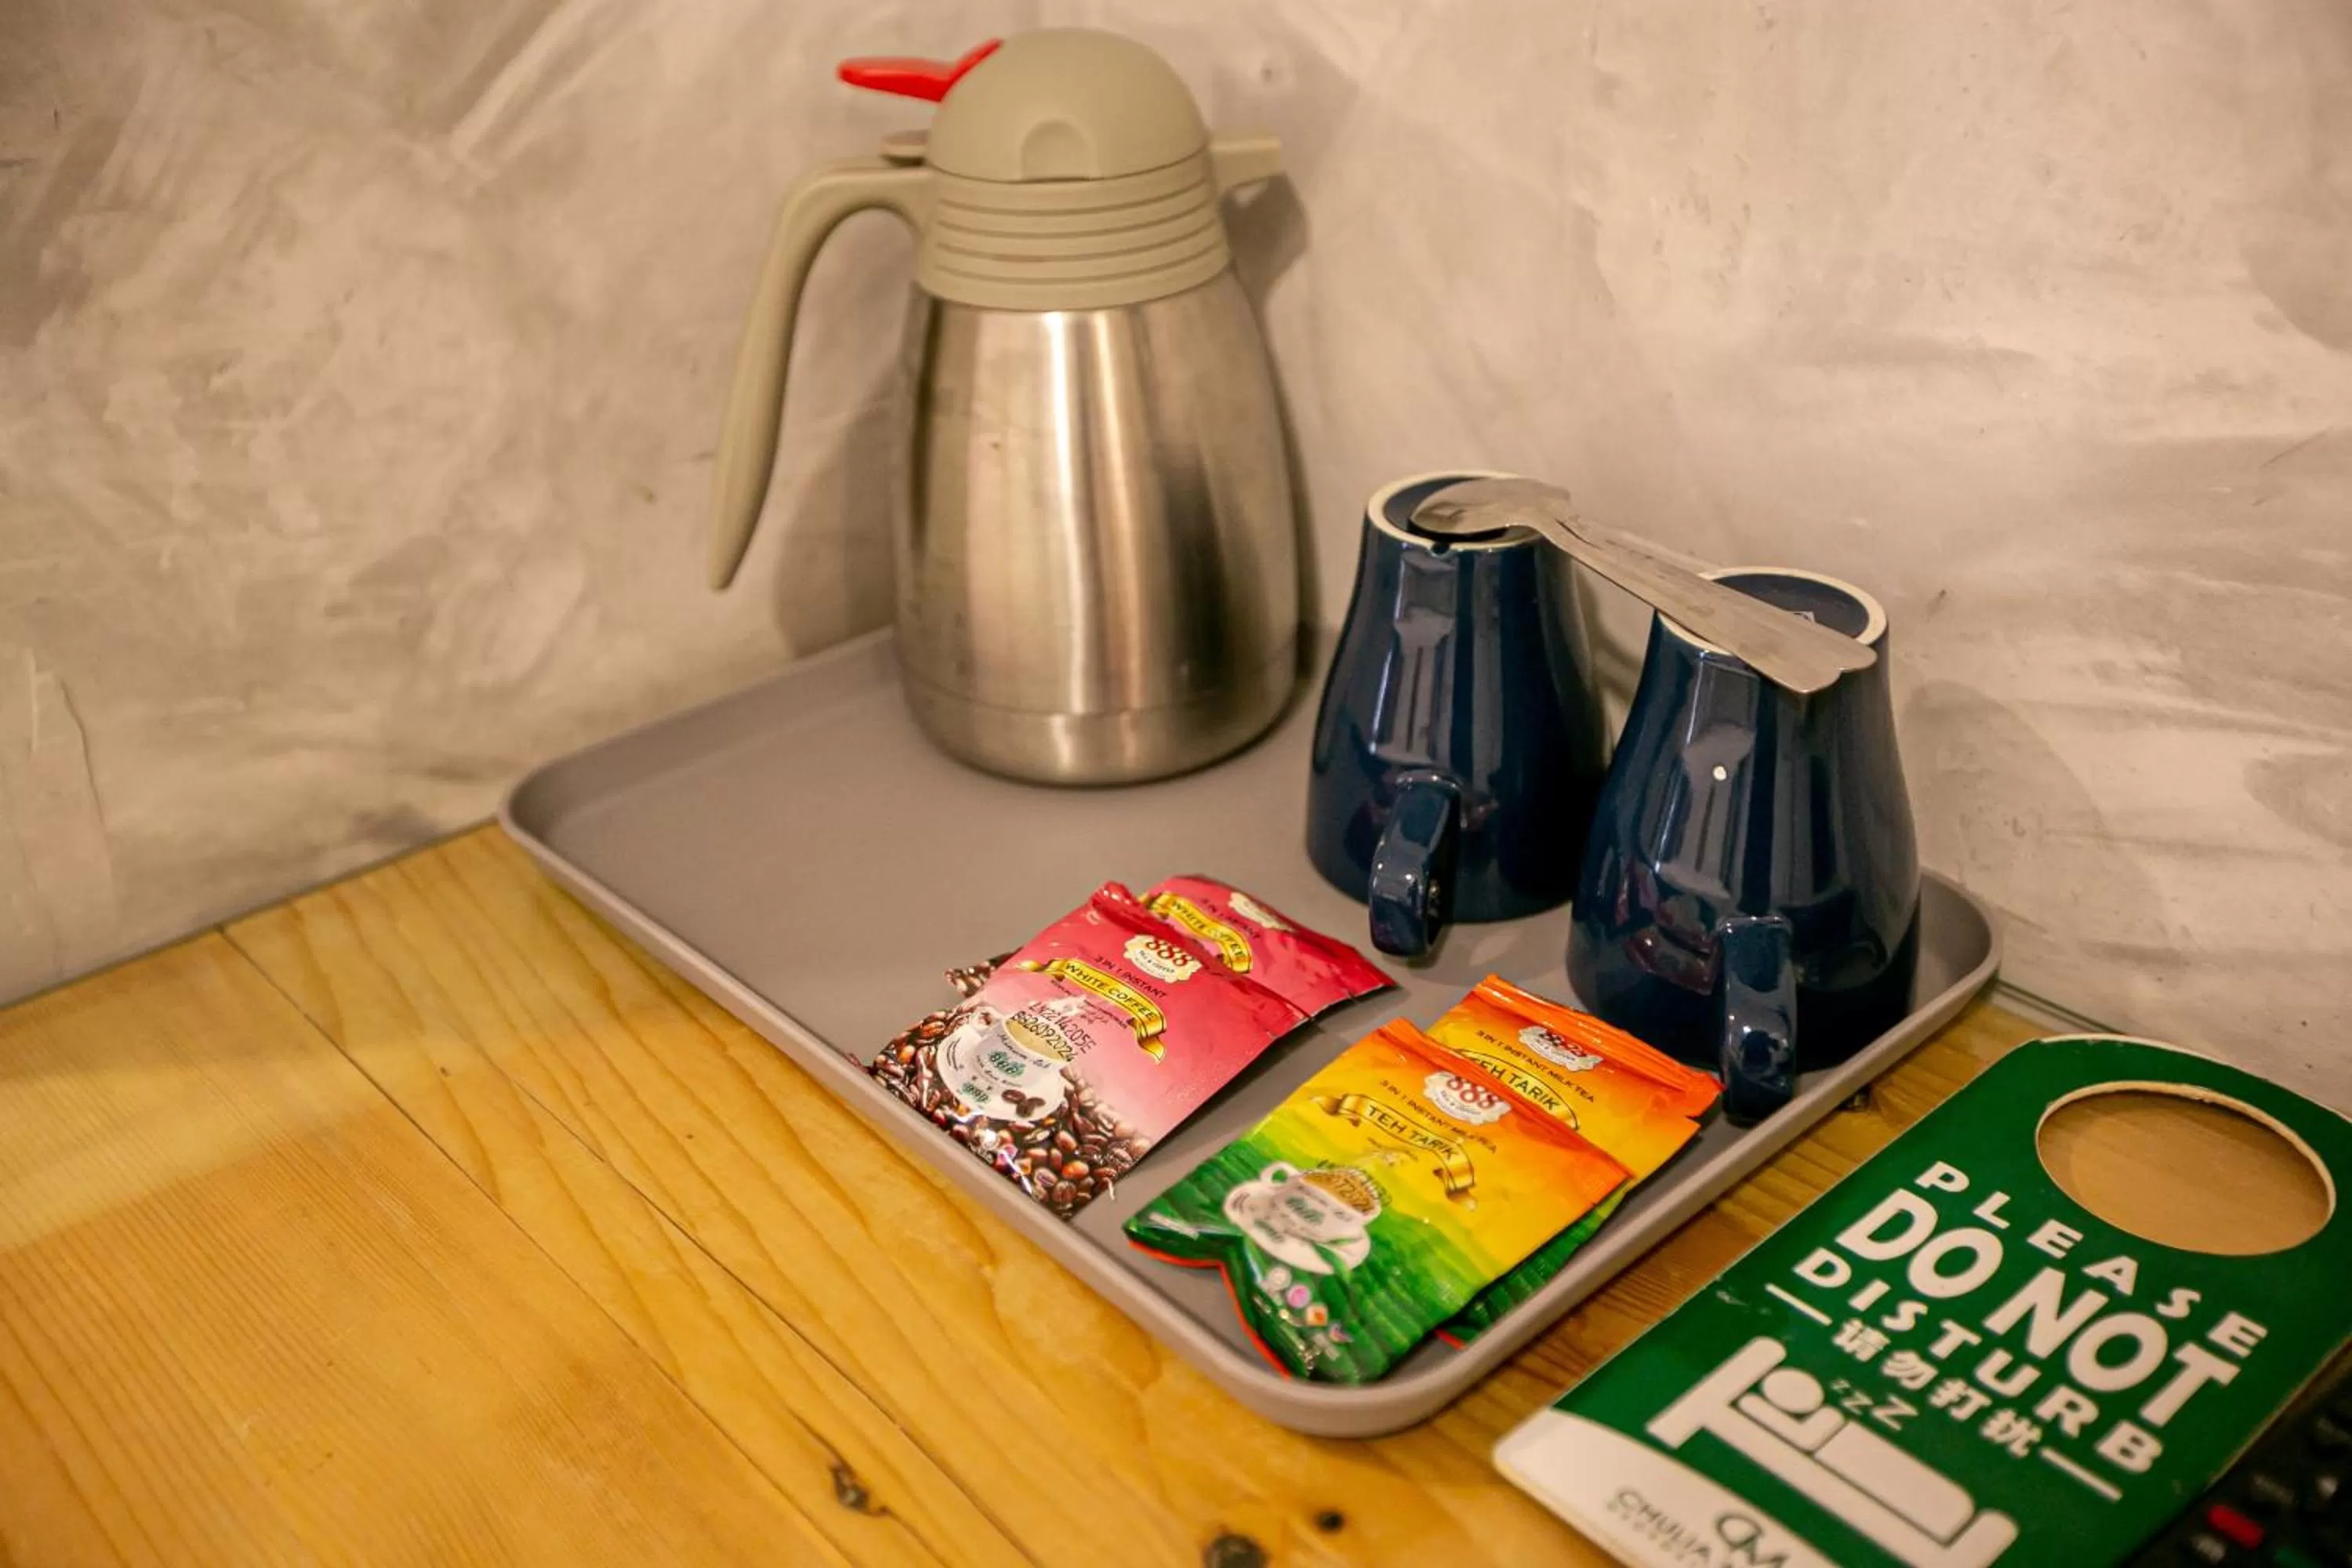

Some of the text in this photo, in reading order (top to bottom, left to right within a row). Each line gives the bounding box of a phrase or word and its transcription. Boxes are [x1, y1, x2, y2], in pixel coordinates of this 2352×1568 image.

[1065, 963, 1107, 990] WHITE
[1107, 986, 1160, 1024] COFFEE
[1121, 971, 1168, 999] INSTANT
[1503, 1044, 1548, 1072] INSTANT
[1547, 1069, 1575, 1089] MILK
[1573, 1084, 1595, 1104] TEA
[1507, 1073, 1563, 1112] TARIK
[1367, 1105, 1408, 1134] TEH
[1408, 1130, 1460, 1160] TARIK
[1913, 1160, 2269, 1359] PLEASE
[1834, 1187, 2241, 1428] DO NOT
[1791, 1247, 2164, 1474] DISTURB
[1831, 1317, 2043, 1460] 请勿打扰
